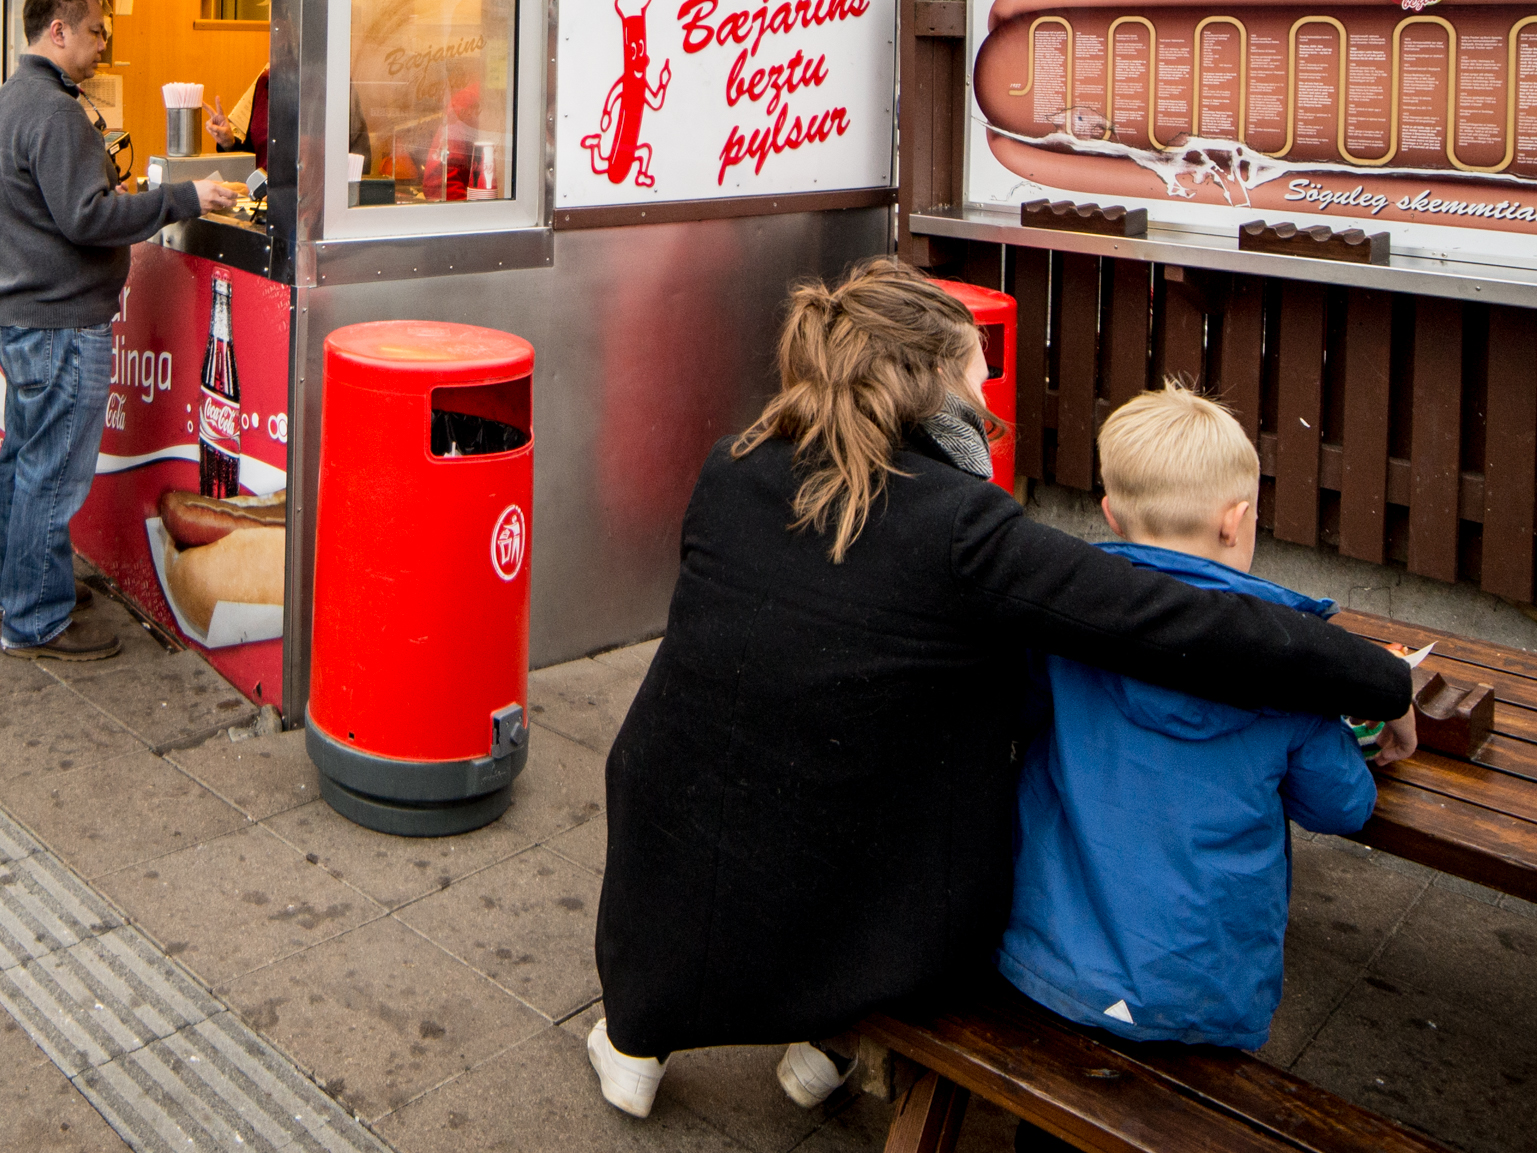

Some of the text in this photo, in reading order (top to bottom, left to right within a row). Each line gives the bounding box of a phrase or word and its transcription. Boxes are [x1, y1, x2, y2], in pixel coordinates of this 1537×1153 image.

[384, 34, 487, 78] Bæjarins
[726, 48, 829, 116] beztu
[717, 102, 851, 186] pylsur
[1285, 178, 1537, 222] Söguleg skemmtia
